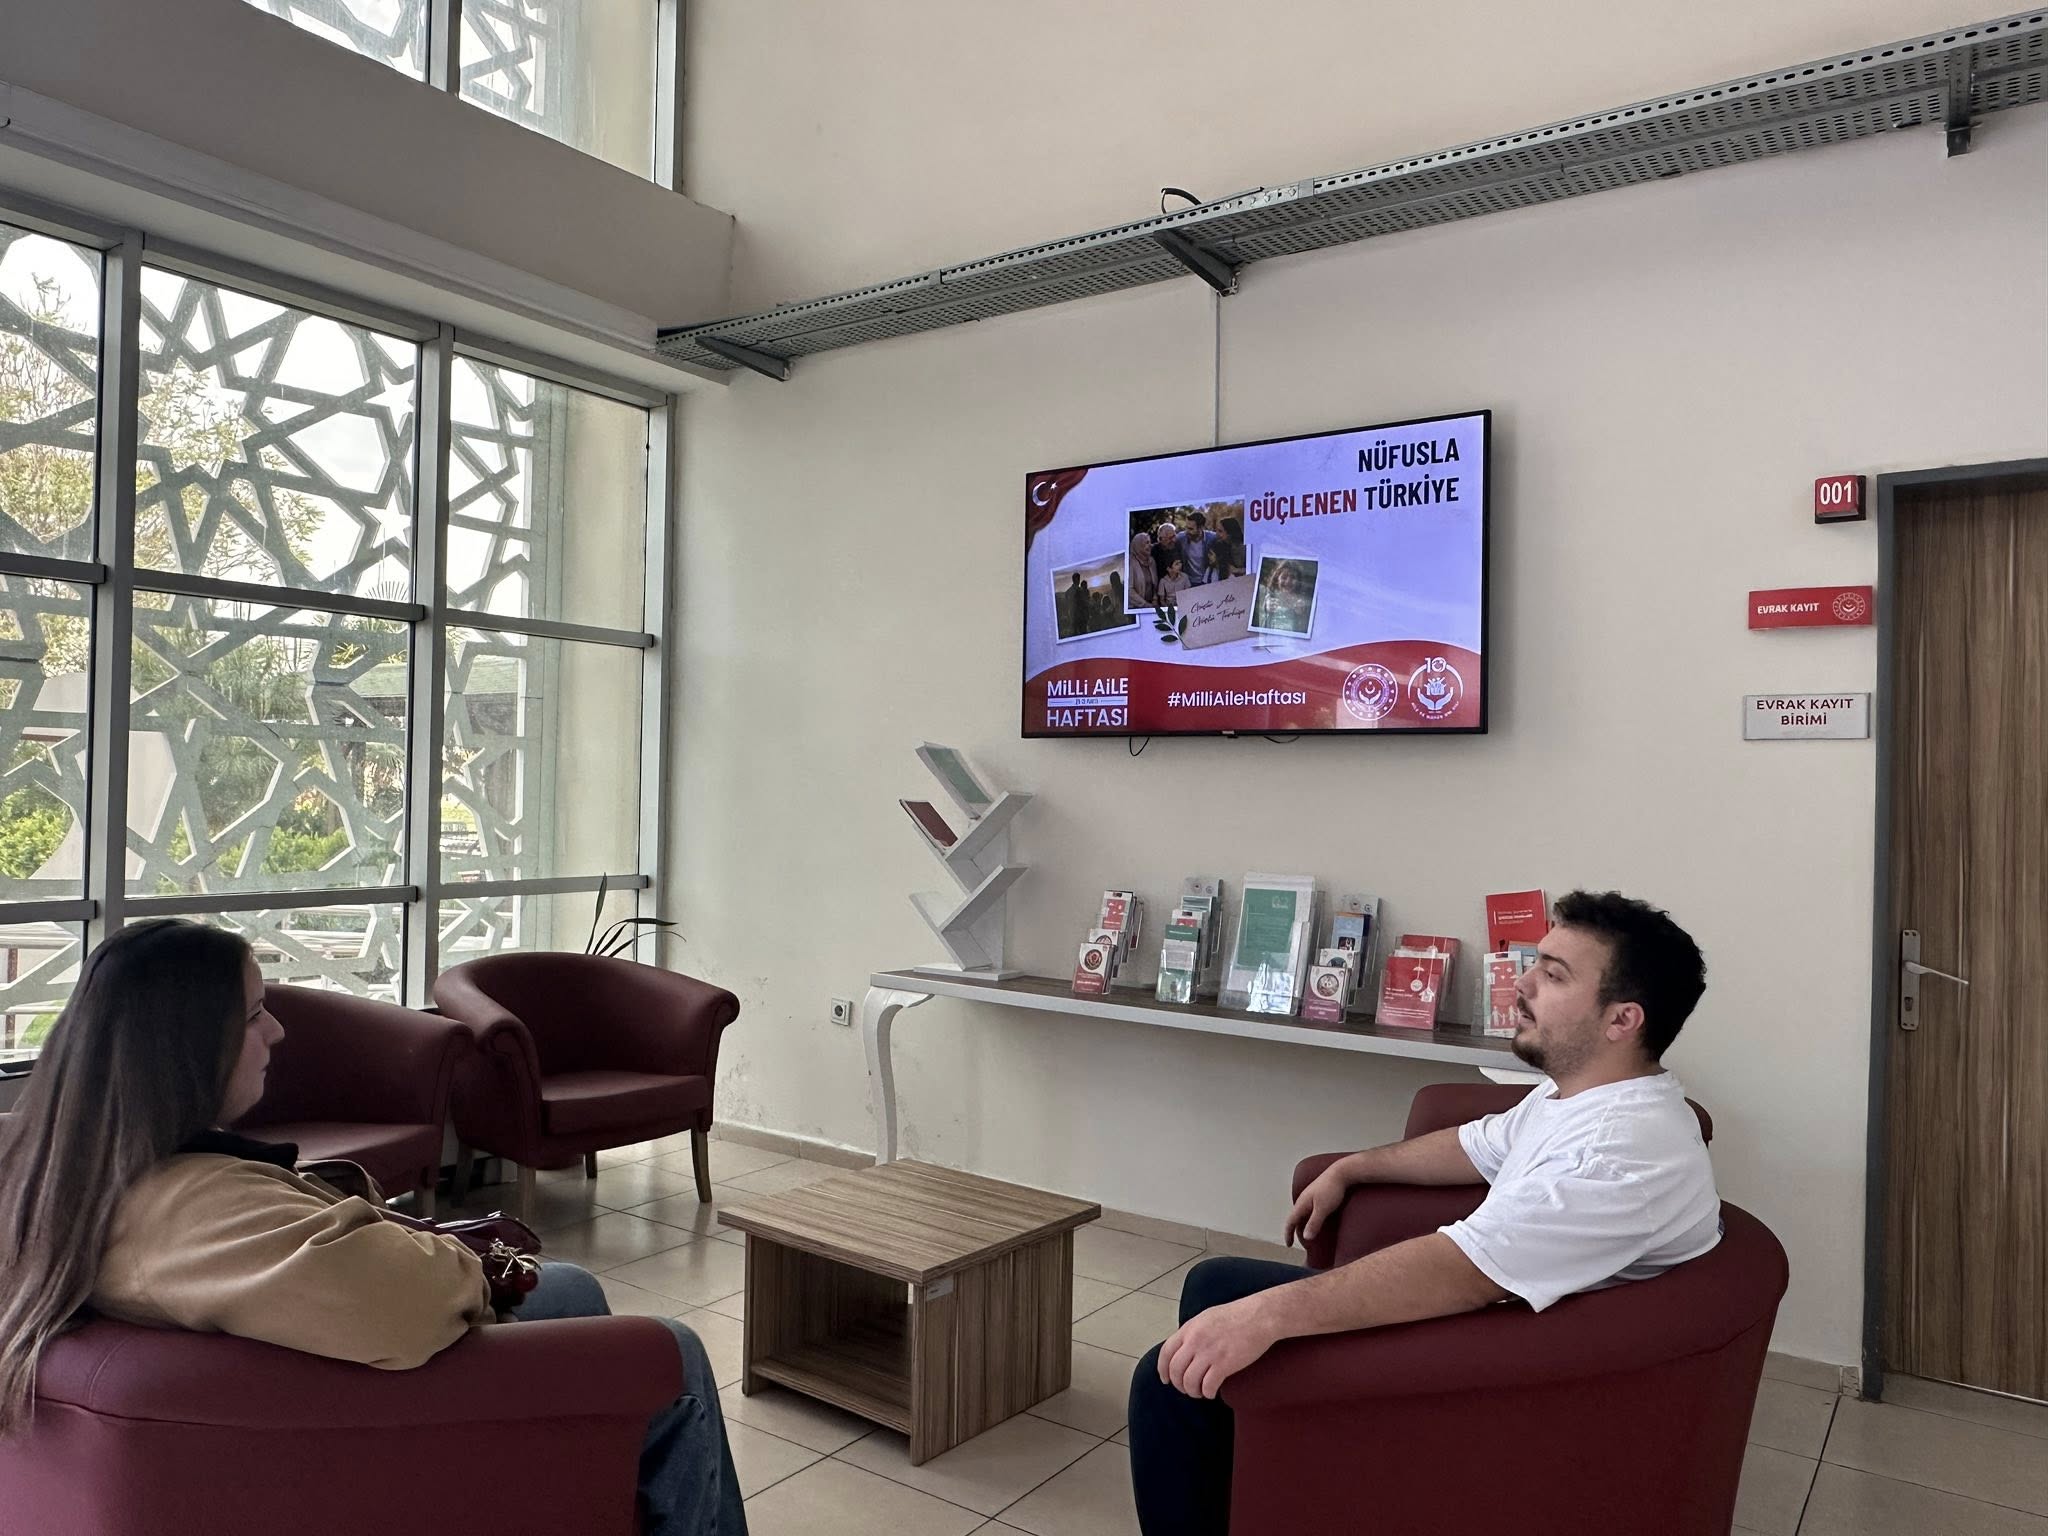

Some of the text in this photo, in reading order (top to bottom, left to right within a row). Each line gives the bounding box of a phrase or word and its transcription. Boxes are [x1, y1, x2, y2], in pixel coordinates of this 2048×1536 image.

[1358, 437, 1460, 473] NÜFUSLA
[1249, 473, 1460, 525] GÜÇLENEN TÜRKİYE
[1819, 480, 1853, 505] 001
[1757, 602, 1820, 615] EVRAK KAYIT
[1167, 688, 1306, 707] #MilliAileHaftası
[1756, 698, 1854, 710] EVRAK KAYIT
[1046, 707, 1128, 728] HAFTASI
[1781, 712, 1827, 726] BİRİMİ
